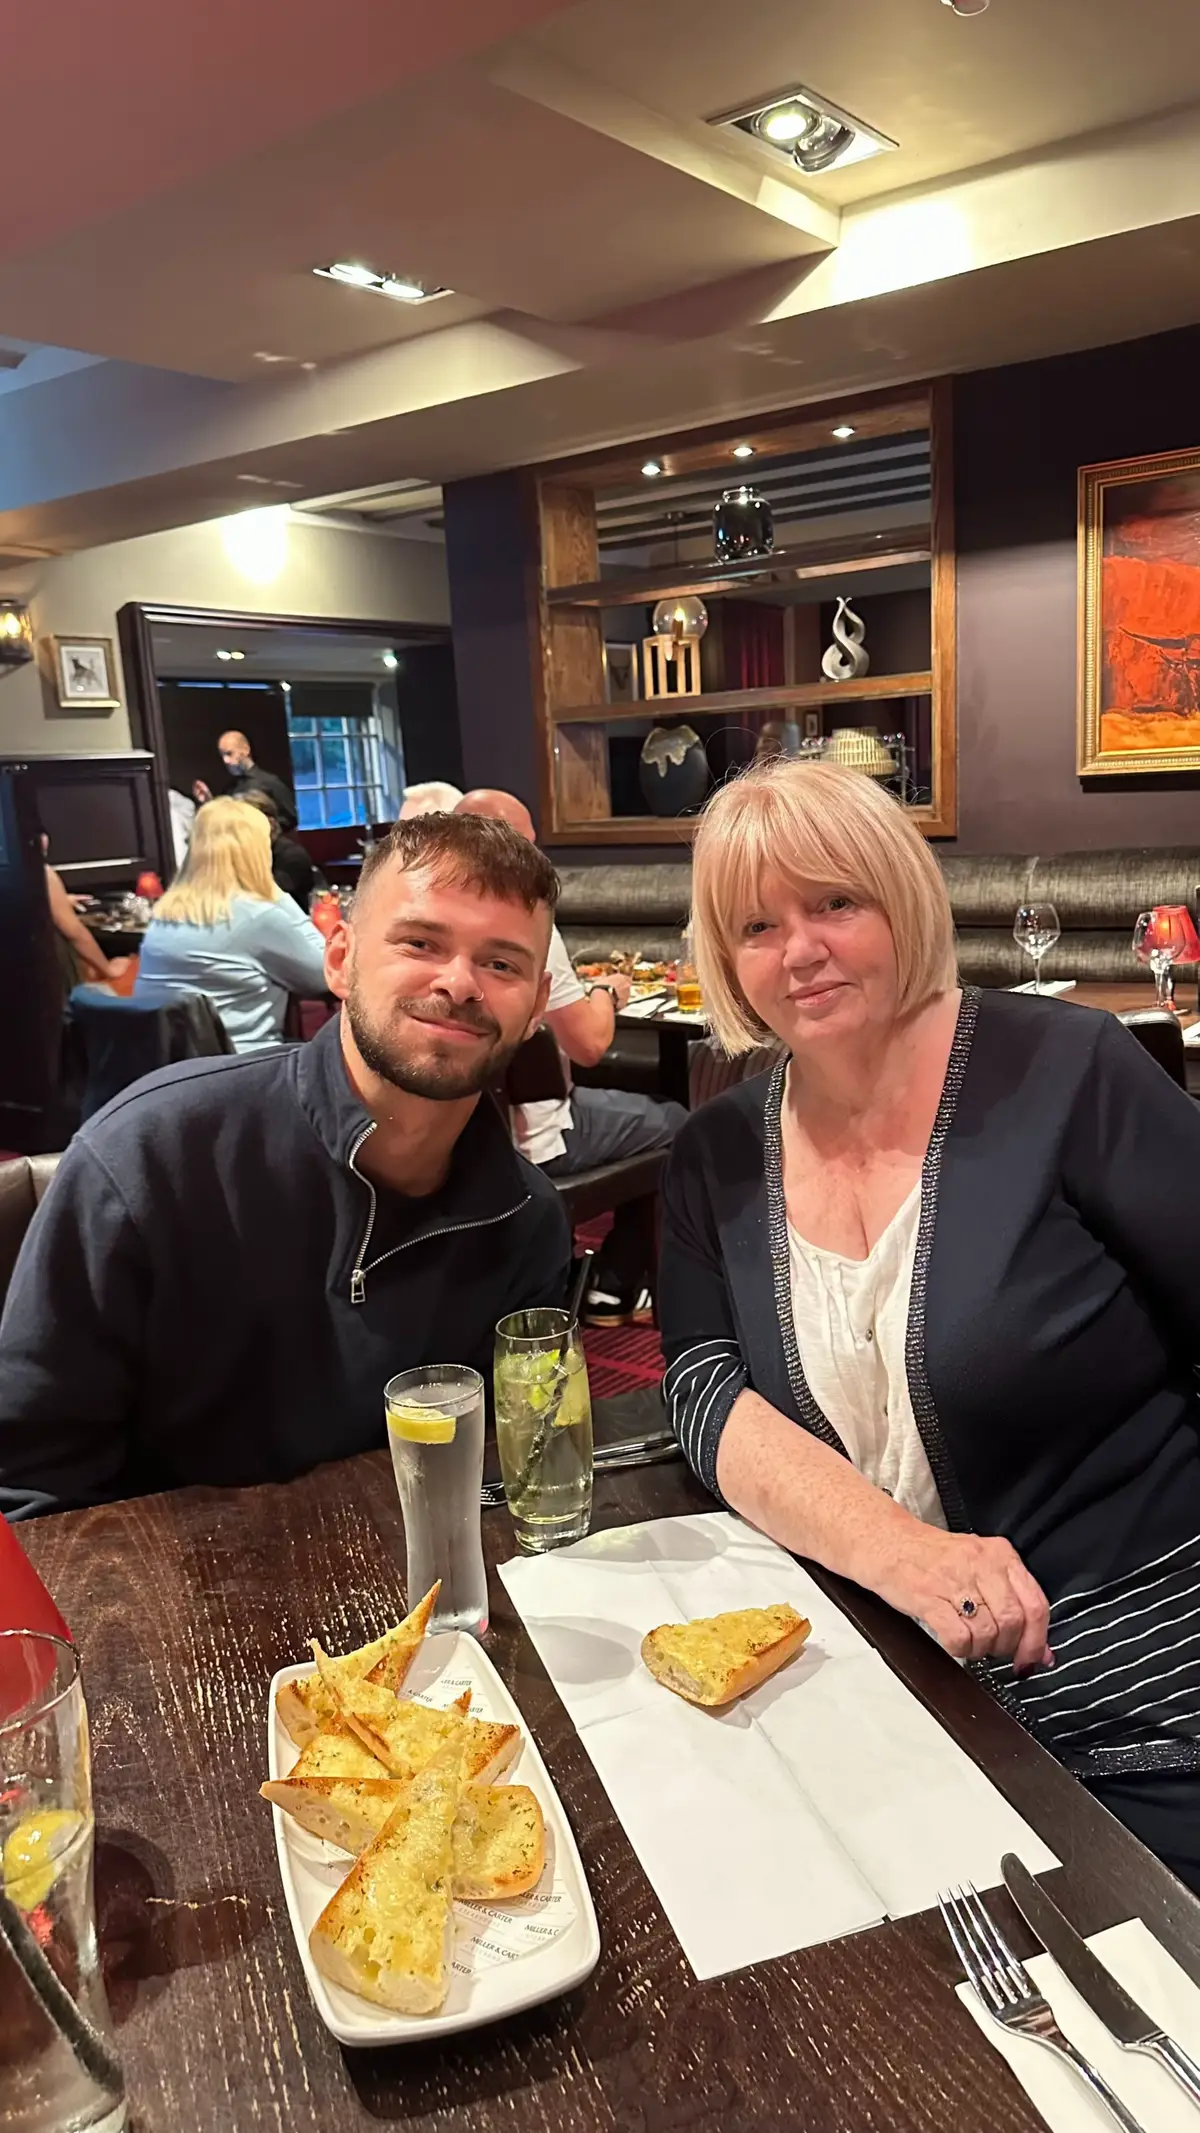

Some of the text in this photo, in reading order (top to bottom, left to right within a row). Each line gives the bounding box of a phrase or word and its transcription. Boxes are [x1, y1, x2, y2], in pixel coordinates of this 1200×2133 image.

[412, 1691, 433, 1703] CARTER
[540, 1895, 562, 1903] CARTER
[488, 1910, 513, 1924] CARTER
[524, 1924, 548, 1935] MILLER
[470, 1936, 495, 1951] MILLER
[451, 1961, 472, 1974] ARTER
